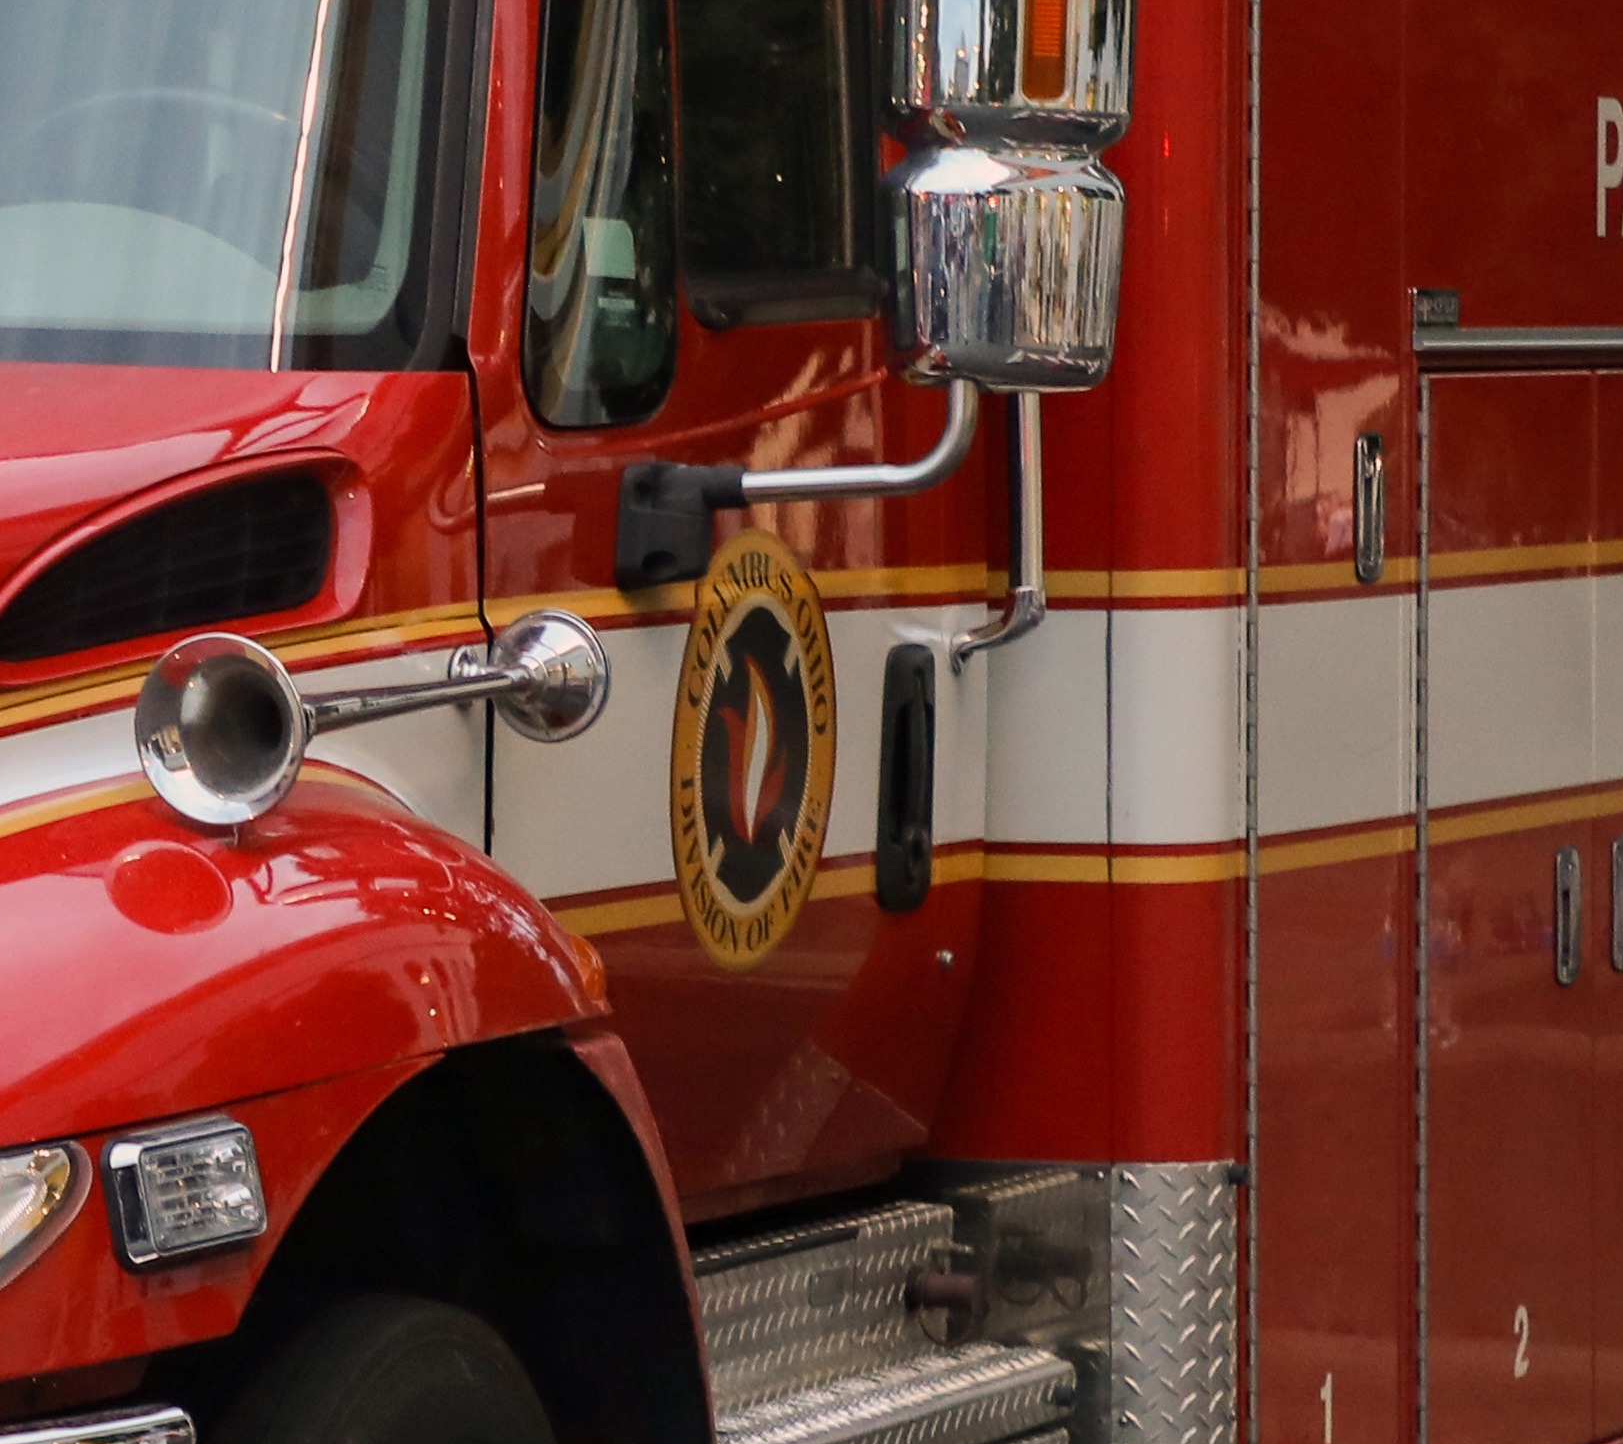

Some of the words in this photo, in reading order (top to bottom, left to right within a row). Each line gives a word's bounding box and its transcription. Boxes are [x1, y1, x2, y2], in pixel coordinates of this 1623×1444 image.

[688, 551, 795, 709] COLUMBUS
[798, 599, 827, 736] OHIO
[679, 774, 740, 953] DIVISION
[746, 905, 776, 952] OF
[782, 796, 824, 915] FIRE
[1513, 1304, 1530, 1378] 2
